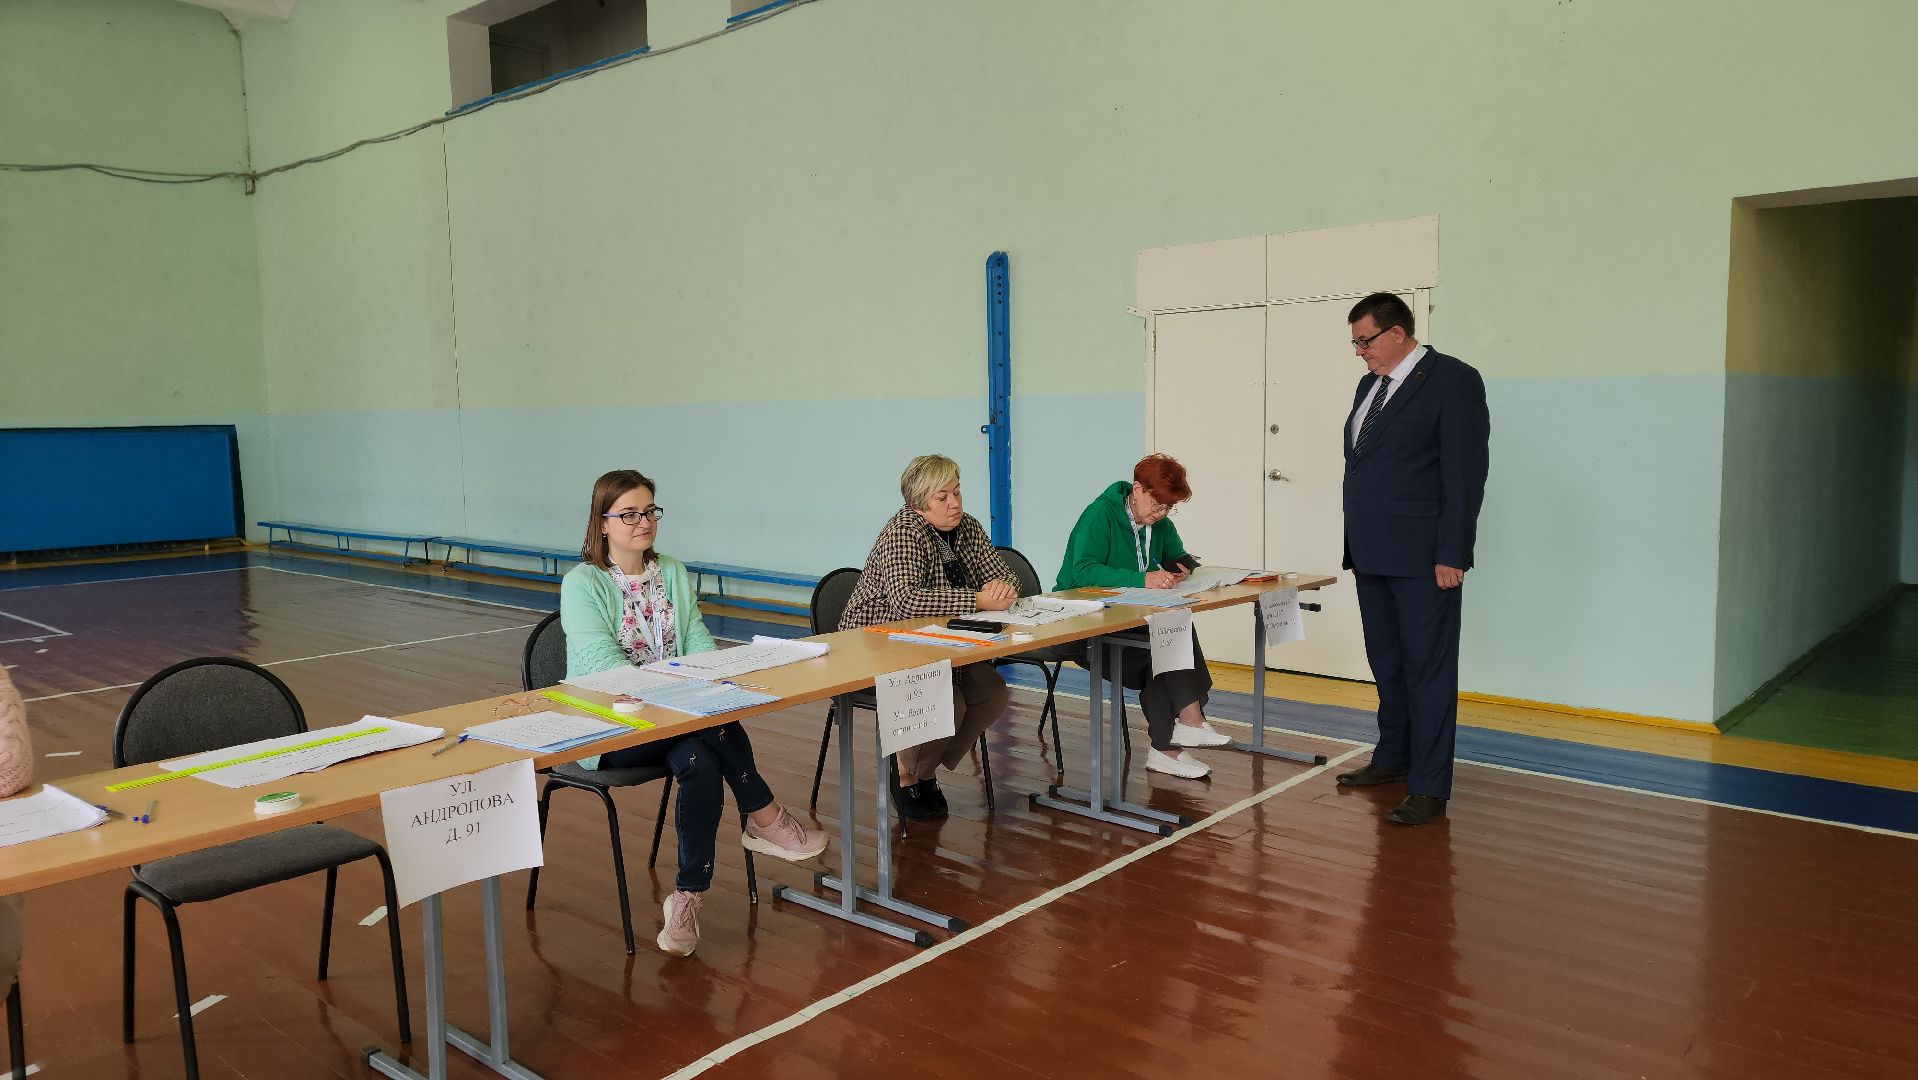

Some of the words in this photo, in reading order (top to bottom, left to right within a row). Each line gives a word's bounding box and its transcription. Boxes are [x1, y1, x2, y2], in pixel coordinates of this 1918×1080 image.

[450, 780, 477, 797] УЛ.
[410, 792, 515, 828] АНДРОПОВА
[445, 828, 462, 845] Д.
[466, 822, 480, 837] 91
